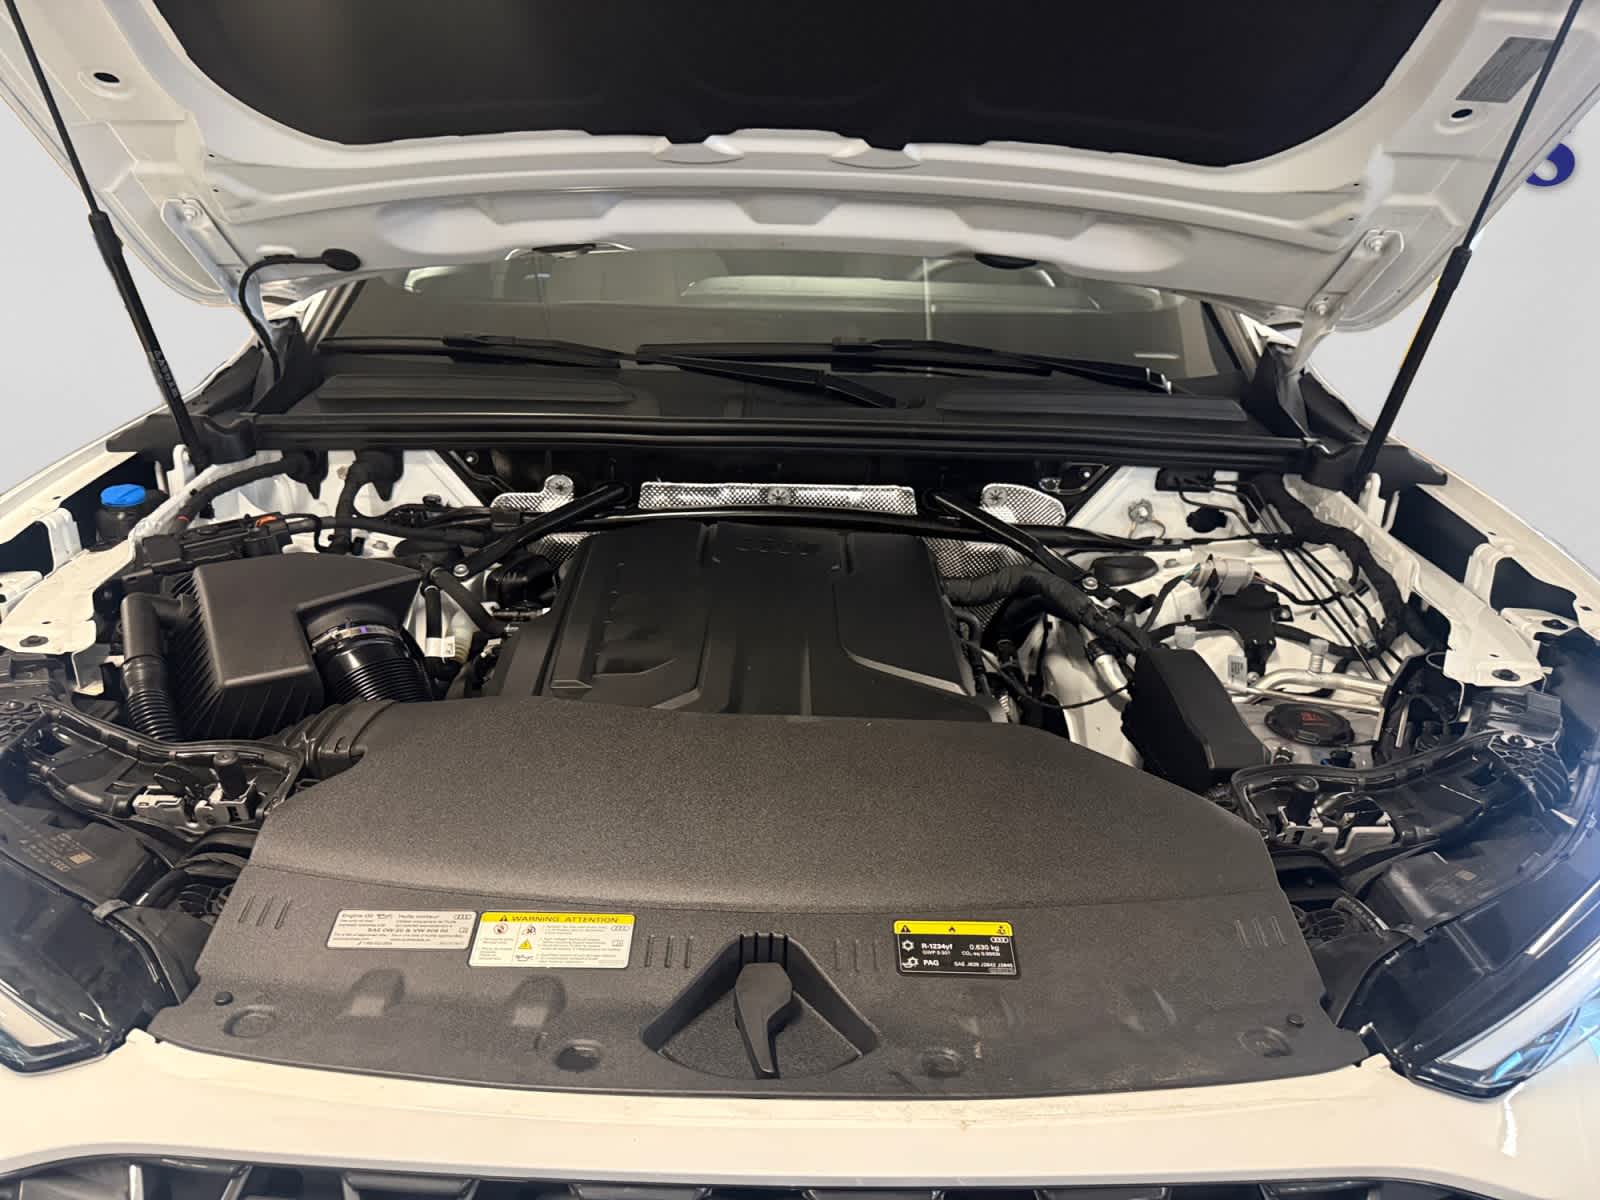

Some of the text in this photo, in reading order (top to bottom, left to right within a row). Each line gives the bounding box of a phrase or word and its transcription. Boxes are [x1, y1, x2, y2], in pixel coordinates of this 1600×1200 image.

[512, 915, 618, 924] WARNING ATTENTION
[921, 943, 952, 951] R-1234yf
[990, 944, 1000, 952] kg
